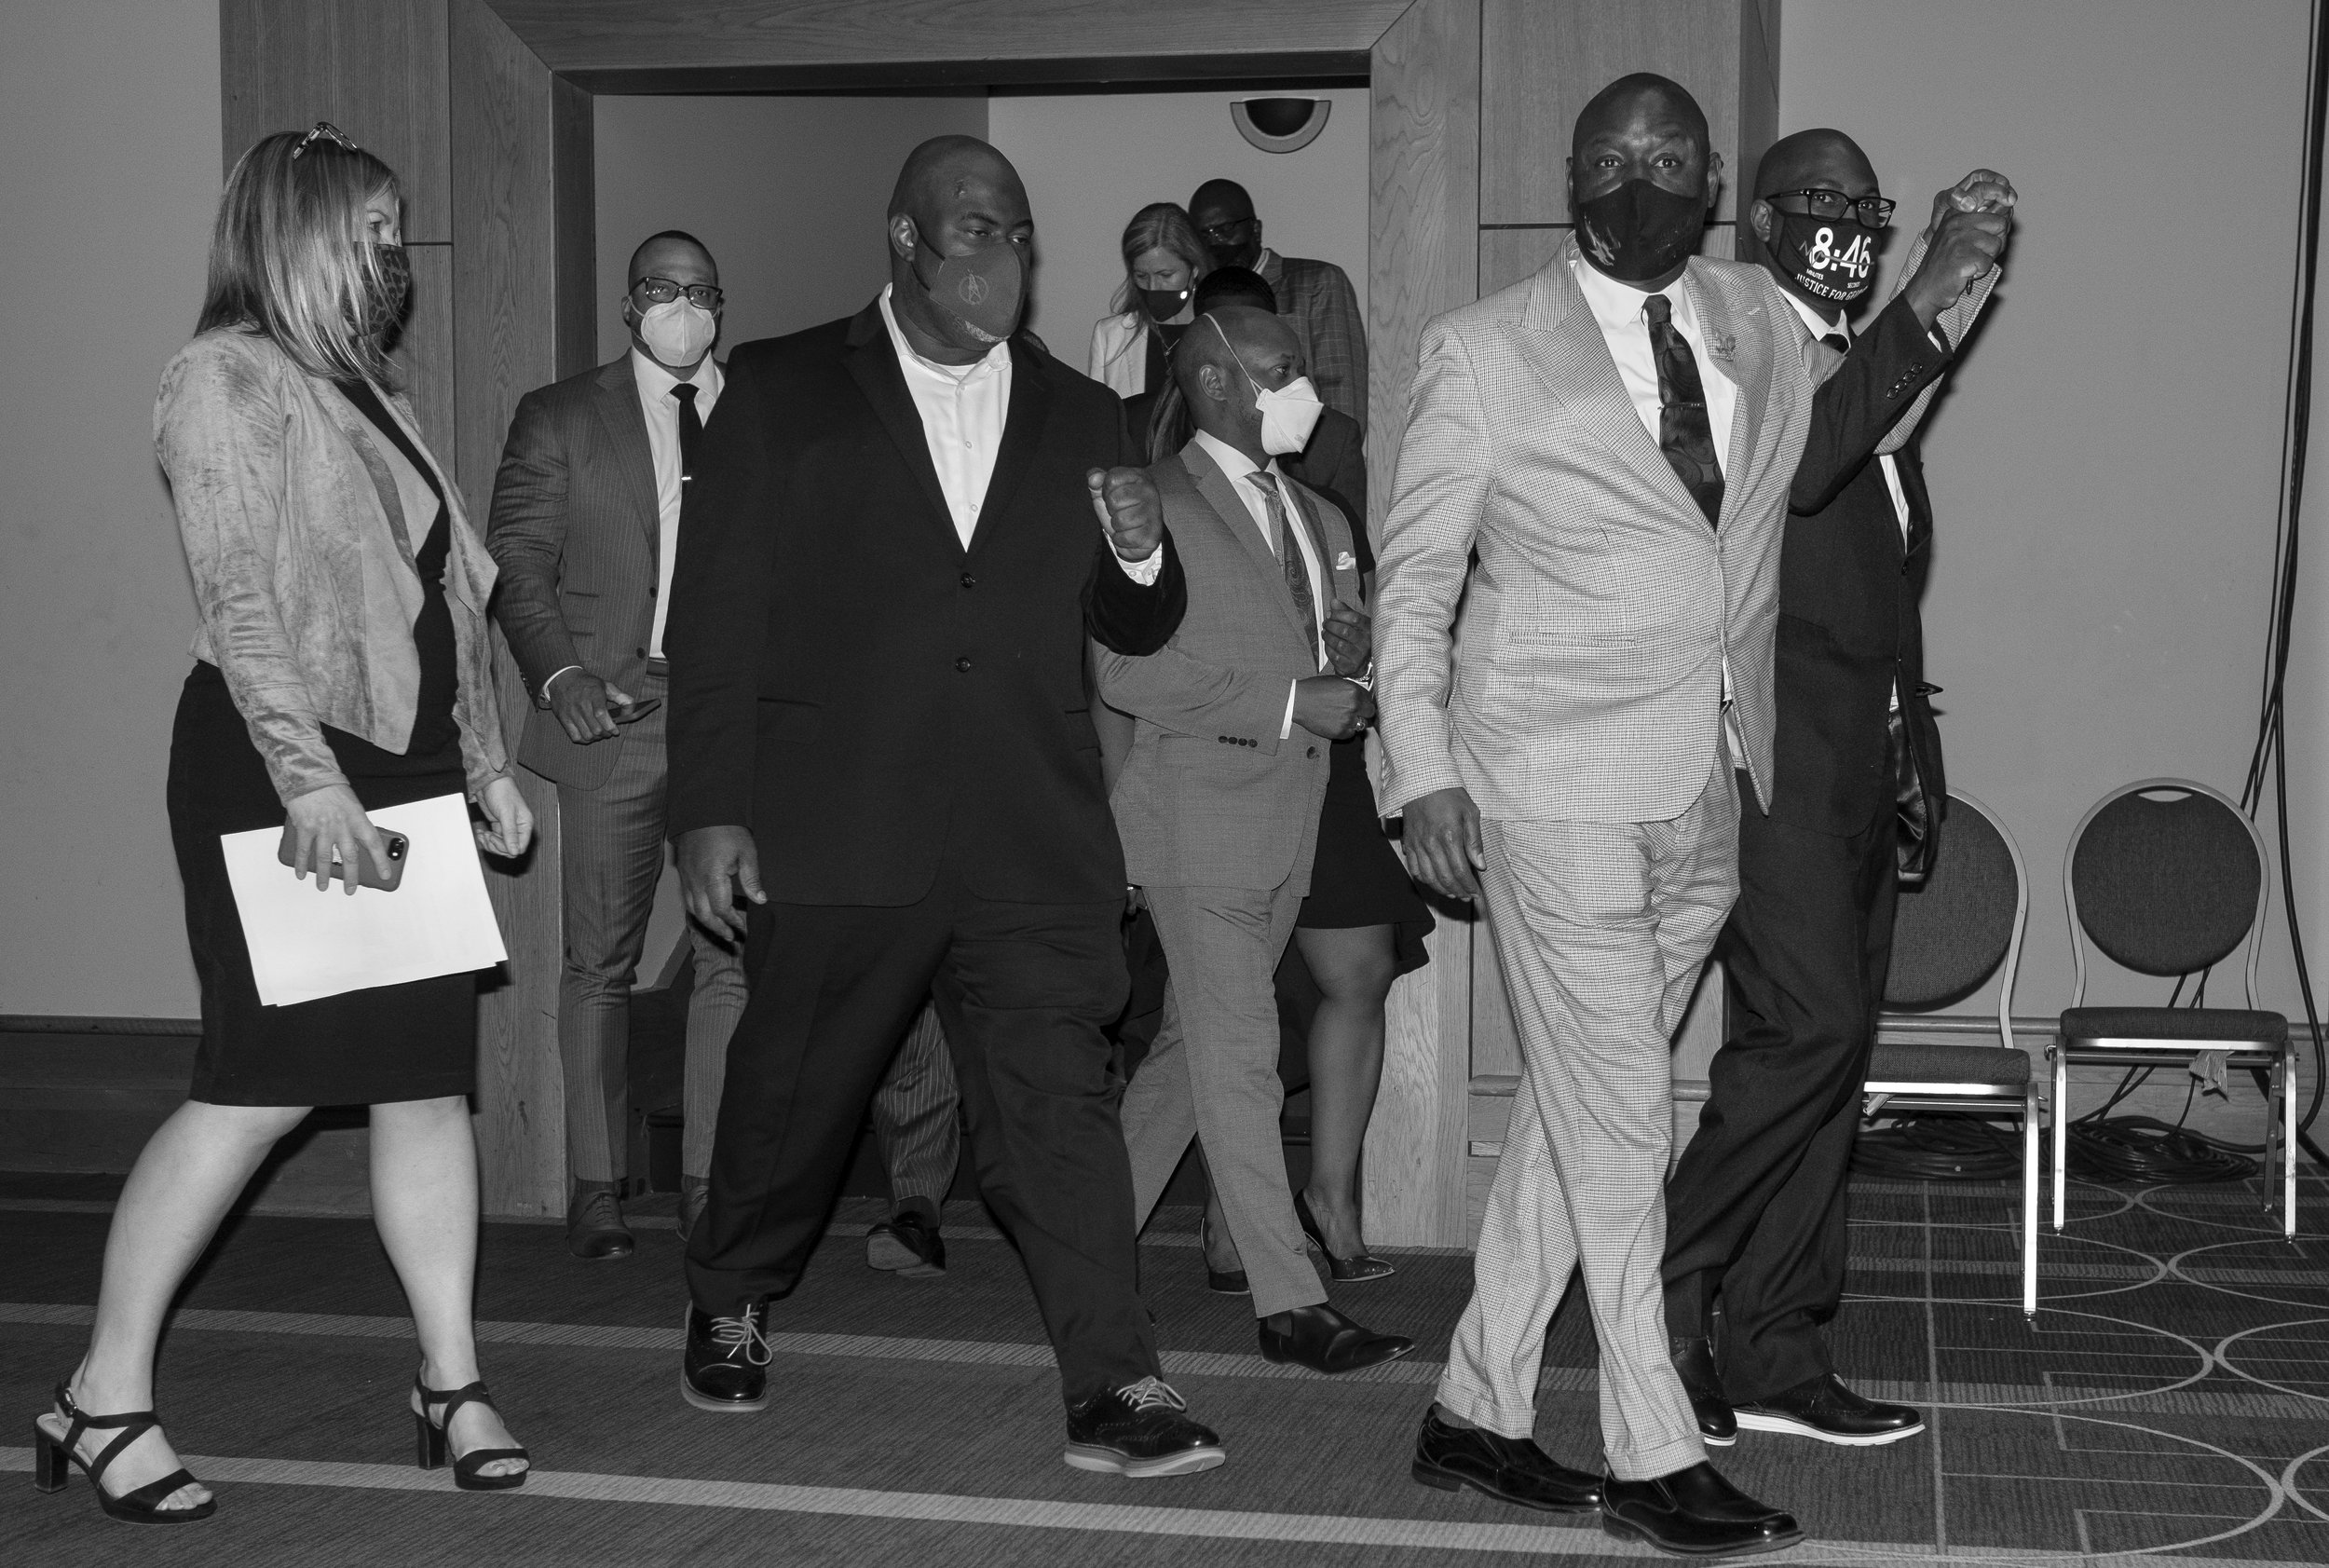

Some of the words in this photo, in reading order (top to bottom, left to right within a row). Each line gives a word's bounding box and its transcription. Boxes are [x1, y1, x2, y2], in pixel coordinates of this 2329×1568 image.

[1809, 227, 1871, 278] 8:46
[1794, 273, 1829, 296] JUSTICE
[1829, 289, 1846, 300] FOR
[1845, 285, 1868, 300] GEO
[1806, 268, 1824, 280] MINUTES
